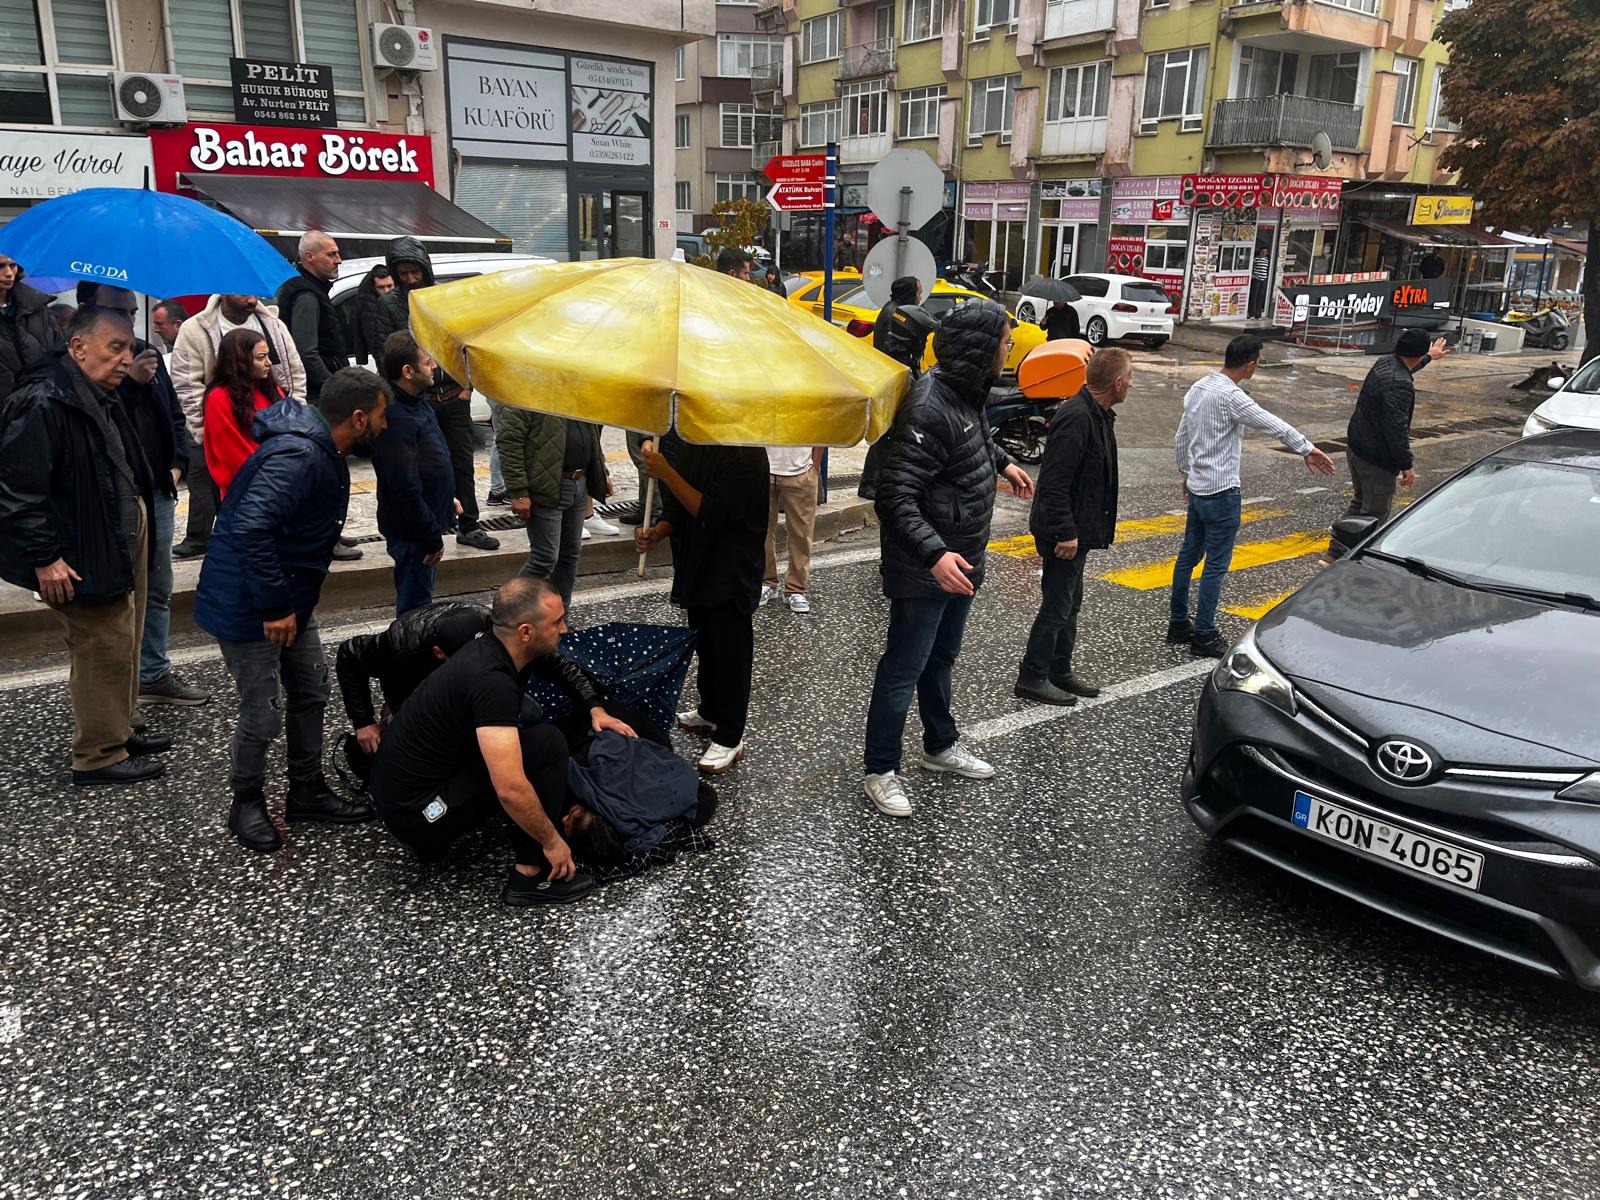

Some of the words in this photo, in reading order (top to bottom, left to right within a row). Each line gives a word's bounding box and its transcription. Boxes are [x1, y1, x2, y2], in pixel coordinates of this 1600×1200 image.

[246, 63, 319, 84] PELİT
[240, 84, 282, 96] HUKUK
[284, 85, 328, 99] BÜROSU
[479, 75, 539, 99] BAYAN
[242, 97, 258, 107] Av.
[260, 98, 296, 109] Nurten
[298, 100, 330, 112] PELİT
[464, 106, 555, 131] KUAFÖRÜ
[54, 148, 124, 175] Varol
[190, 127, 308, 171] Bahar
[318, 134, 419, 175] Börek
[10, 186, 43, 196] NAIL
[70, 261, 128, 280] CRODA
[1215, 277, 1233, 285] EKMEK
[1393, 284, 1428, 306] EXTRA
[1318, 295, 1346, 320] Day
[1347, 292, 1384, 317] Today
[1295, 811, 1307, 821] GR
[1315, 804, 1476, 883] KON-4065
